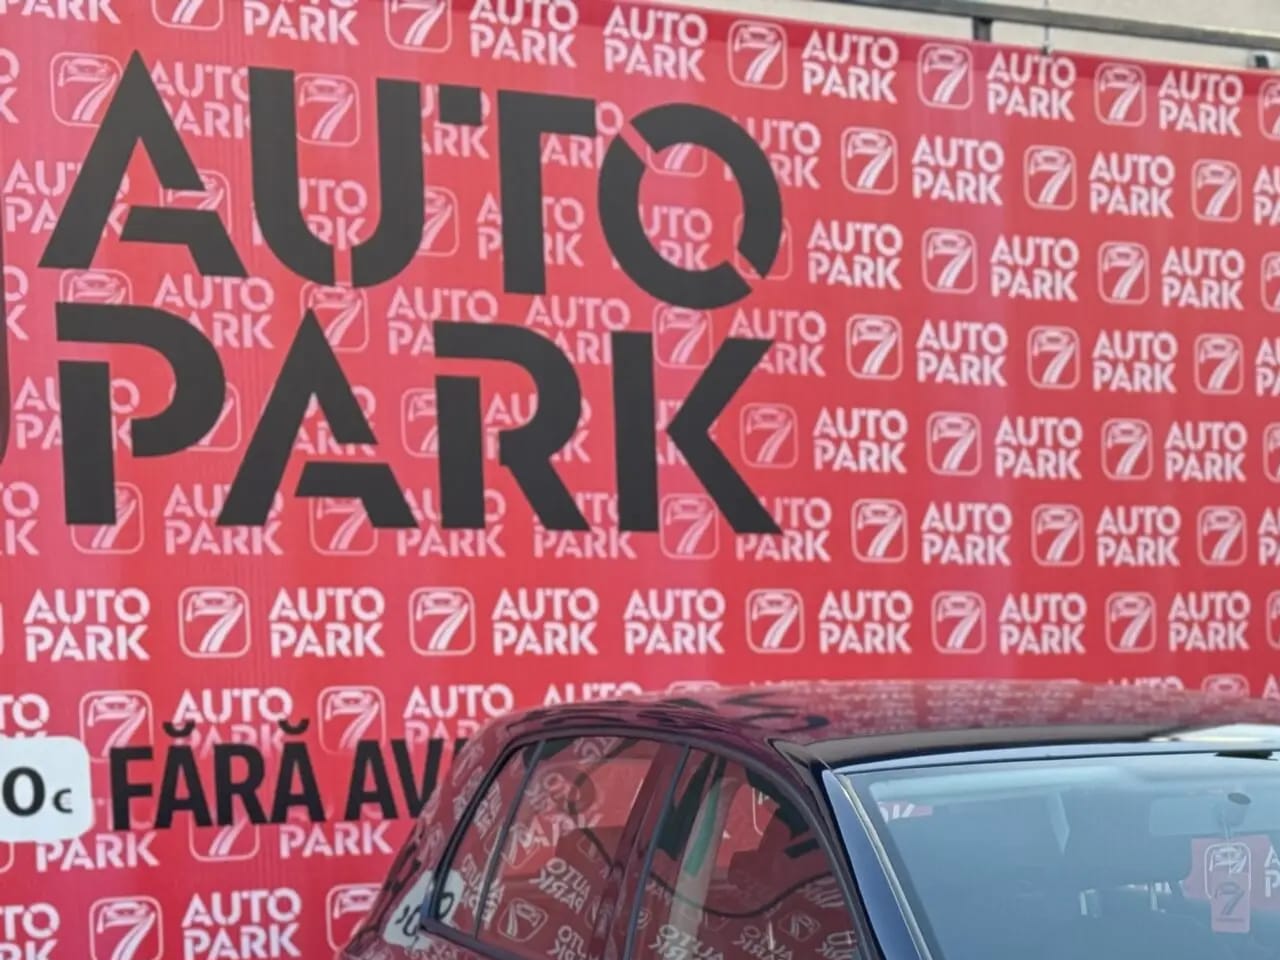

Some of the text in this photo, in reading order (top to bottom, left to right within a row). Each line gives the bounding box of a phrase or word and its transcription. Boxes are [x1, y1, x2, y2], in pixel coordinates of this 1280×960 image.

[243, 1, 360, 45] PARK
[603, 6, 707, 46] AUTO
[469, 21, 576, 68] PARK
[604, 37, 705, 81] PARK
[802, 31, 899, 69] AUTO
[801, 60, 897, 104] PARK
[985, 50, 1076, 88] AUTO
[1157, 68, 1243, 105] AUTO
[986, 81, 1075, 122] PARK
[1157, 98, 1242, 137] PARK
[911, 135, 1005, 173] AUTO
[1088, 152, 1176, 187] AUTO
[38, 50, 783, 310] AUTO
[912, 165, 1003, 207] PARK
[1089, 182, 1173, 219] PARK
[807, 220, 903, 257] AUTO
[990, 234, 1080, 270] AUTO
[808, 250, 902, 291] PARK
[1161, 246, 1246, 280] AUTO
[153, 273, 274, 311] AUTO
[990, 265, 1078, 302] PARK
[1161, 275, 1244, 311] PARK
[387, 287, 498, 323] AUTO
[525, 295, 631, 330] AUTO
[728, 309, 826, 343] AUTO
[916, 320, 1008, 355] AUTO
[1092, 330, 1178, 361] AUTO
[916, 350, 1008, 388] PARK
[1092, 360, 1176, 394] PARK
[54, 301, 784, 534] PARK
[813, 407, 909, 442] AUTO
[994, 416, 1083, 448] AUTO
[1164, 421, 1248, 451] AUTO
[814, 437, 907, 474] PARK
[995, 447, 1082, 480] PARK
[1164, 450, 1246, 482] PARK
[920, 501, 1013, 534] AUTO
[1096, 504, 1181, 536] AUTO
[165, 520, 284, 556] PARK
[921, 533, 1012, 567] PARK
[1096, 535, 1180, 567] PARK
[23, 587, 150, 625] AUTO
[268, 586, 385, 622] AUTO
[491, 587, 600, 622] AUTO
[623, 588, 726, 621] AUTO
[817, 589, 913, 622] AUTO
[998, 592, 1088, 624] AUTO
[1168, 590, 1252, 622] AUTO
[24, 624, 150, 663] PARK
[270, 621, 385, 658] PARK
[492, 621, 598, 656] PARK
[624, 620, 725, 655] PARK
[819, 621, 912, 654] PARK
[999, 623, 1086, 656] PARK
[1168, 619, 1250, 652] PARK
[172, 688, 293, 723] AUTO
[403, 684, 513, 719] AUTO
[110, 719, 470, 831] FĂRĂ AV
[36, 830, 160, 872] PARK
[279, 822, 393, 859] PARK
[181, 886, 303, 928] AUTO
